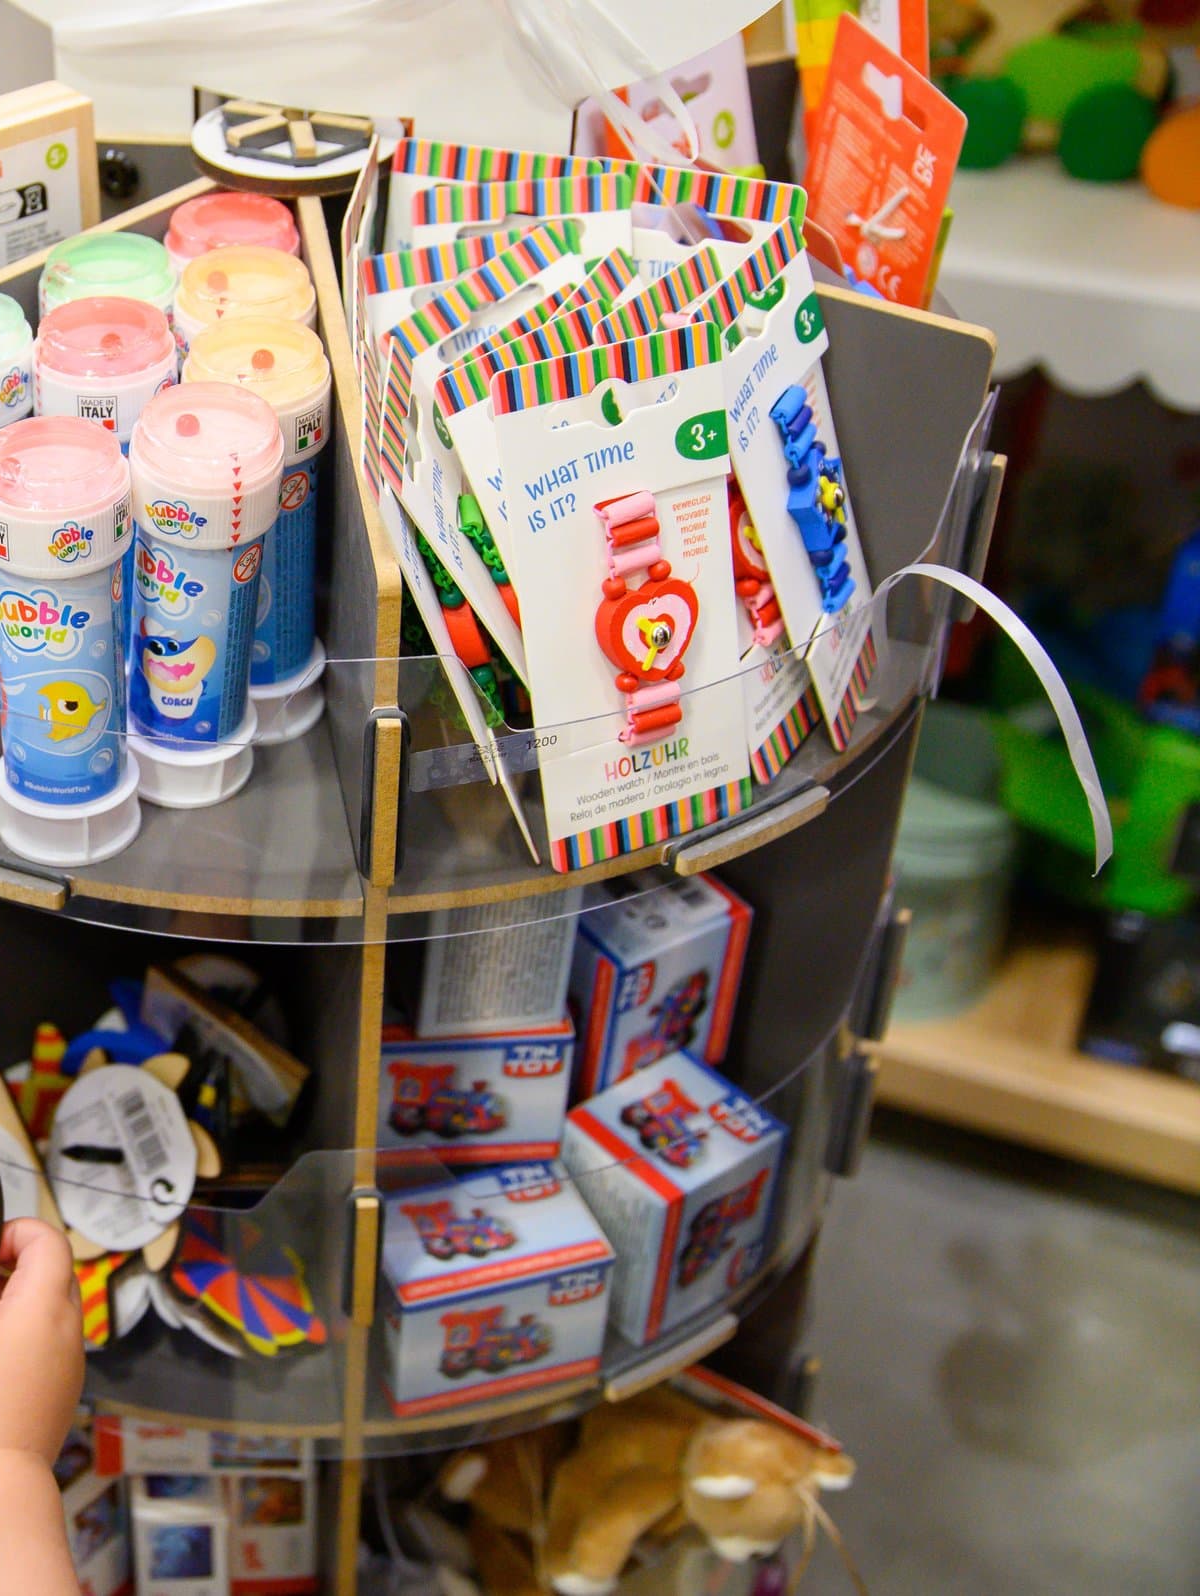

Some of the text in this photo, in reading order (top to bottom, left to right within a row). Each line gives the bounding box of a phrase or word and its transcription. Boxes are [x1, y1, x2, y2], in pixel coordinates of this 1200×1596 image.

[81, 399, 115, 407] MADE IN
[81, 406, 114, 419] ITALY
[297, 417, 322, 438] ITALY
[691, 423, 717, 452] 3+
[144, 503, 208, 527] bubble
[528, 492, 577, 533] IS IT?
[156, 518, 193, 533] world
[48, 526, 93, 557] bubble
[60, 540, 87, 559] world
[6, 623, 68, 643] world
[526, 734, 557, 751] 1200
[605, 737, 689, 782] HOLZUHR
[576, 788, 616, 805] Wooden
[617, 777, 645, 793] watch
[654, 764, 686, 781] Montre
[701, 752, 720, 764] bois
[570, 802, 593, 822] Reloj
[594, 802, 607, 814] de
[608, 791, 645, 809] madera
[654, 776, 692, 795] Orologio
[704, 764, 729, 780] legno
